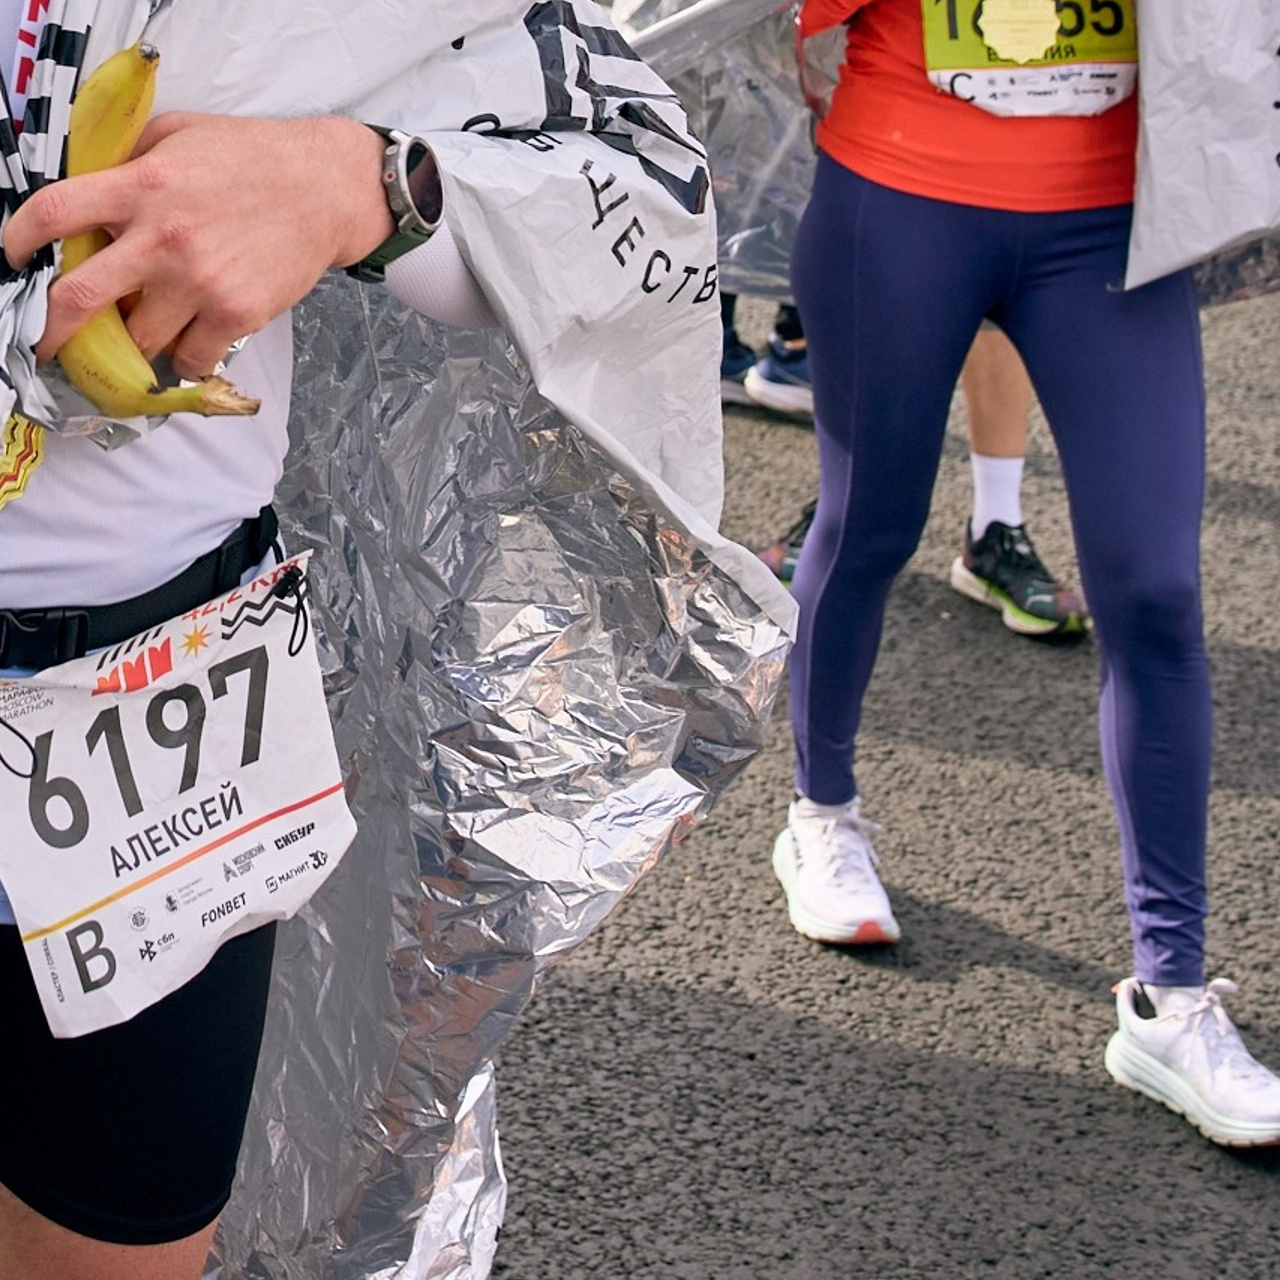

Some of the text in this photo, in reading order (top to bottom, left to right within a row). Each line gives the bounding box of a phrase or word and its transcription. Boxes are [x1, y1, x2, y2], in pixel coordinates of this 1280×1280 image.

[27, 644, 269, 850] 6197
[110, 781, 245, 878] АЛЕКСЕЙ
[274, 822, 315, 851] СИБУР
[278, 861, 310, 885] МАГНИТ
[201, 892, 246, 928] FONBET
